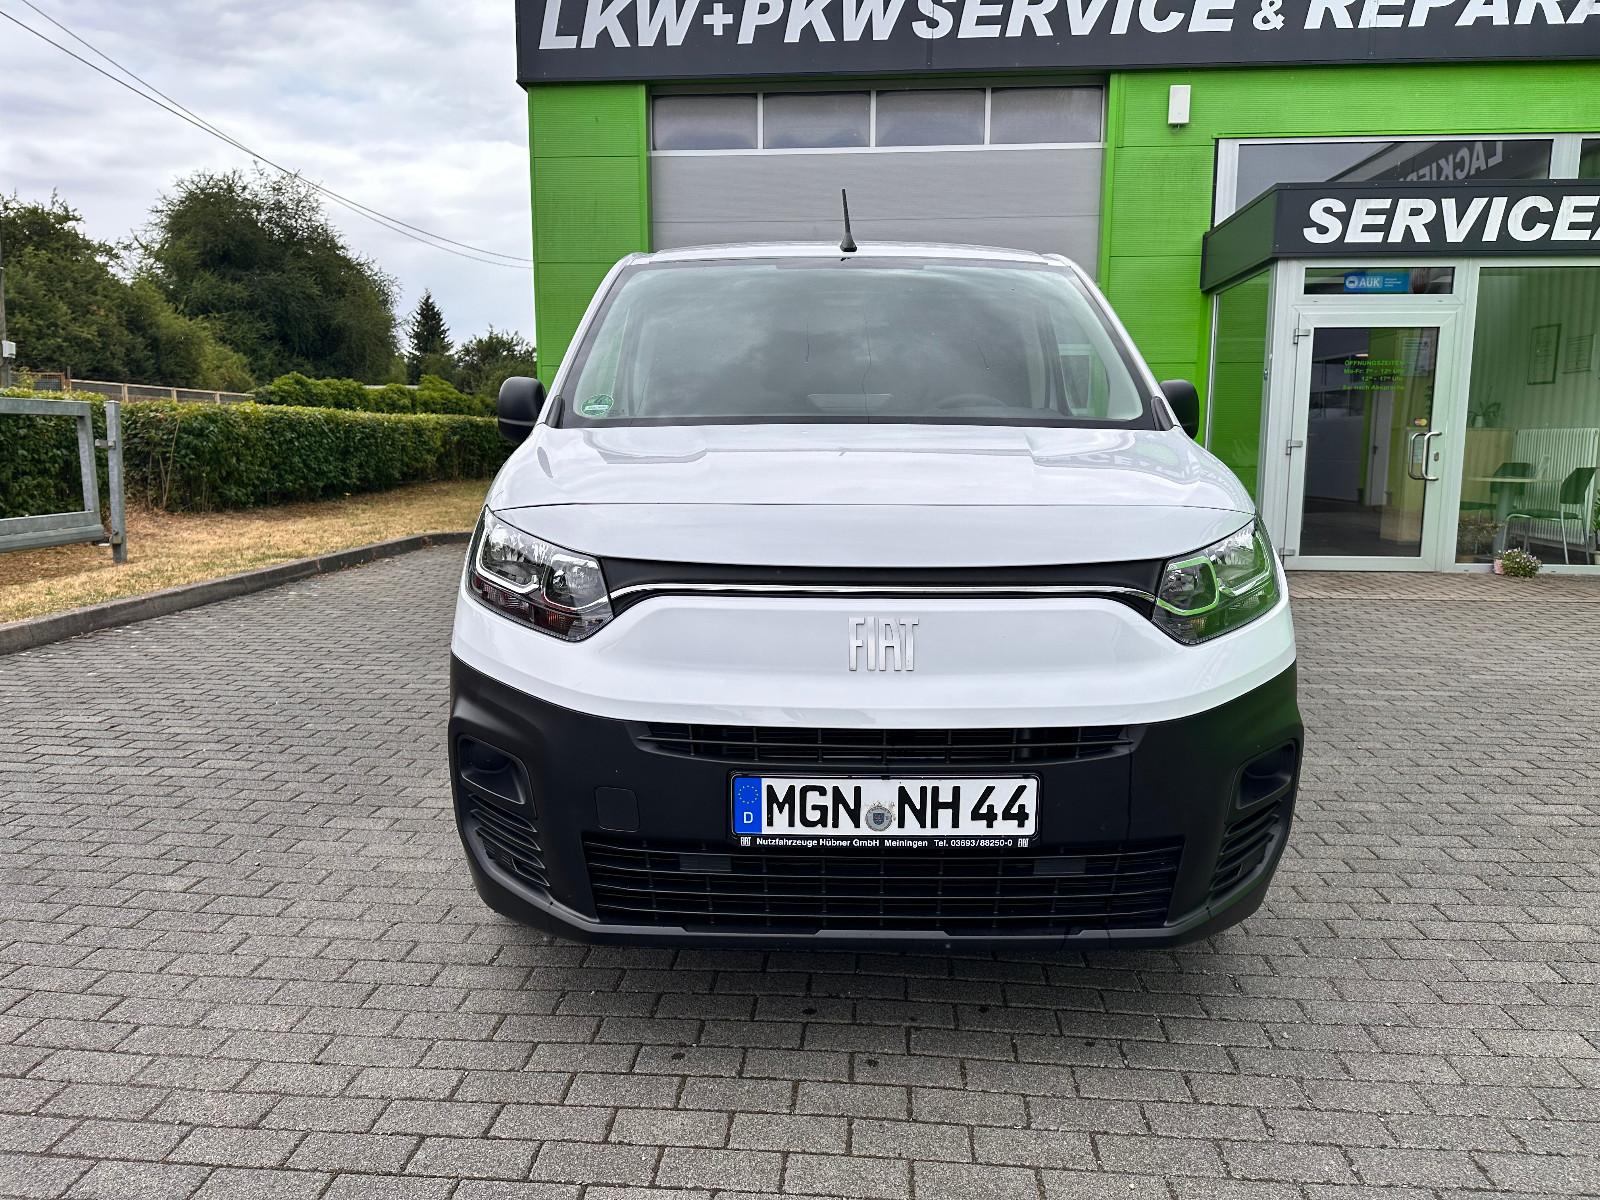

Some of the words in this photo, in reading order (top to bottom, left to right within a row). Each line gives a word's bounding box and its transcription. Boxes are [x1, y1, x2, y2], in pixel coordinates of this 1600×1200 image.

[1252, 0, 1285, 31] &
[1303, 195, 1600, 243] SERVICE
[1358, 277, 1381, 288] AUK
[848, 616, 919, 672] FIAT
[743, 811, 754, 824] D
[766, 784, 862, 829] MGN
[899, 785, 960, 829] NH
[970, 785, 1030, 829] 44
[756, 838, 818, 848] Nutzfahrzeuge
[819, 838, 851, 847] Hübner
[852, 839, 880, 847] GmbH
[884, 839, 929, 849] Meiningen
[934, 839, 949, 848] Tel.
[950, 839, 1013, 848] 03693/88250-0
